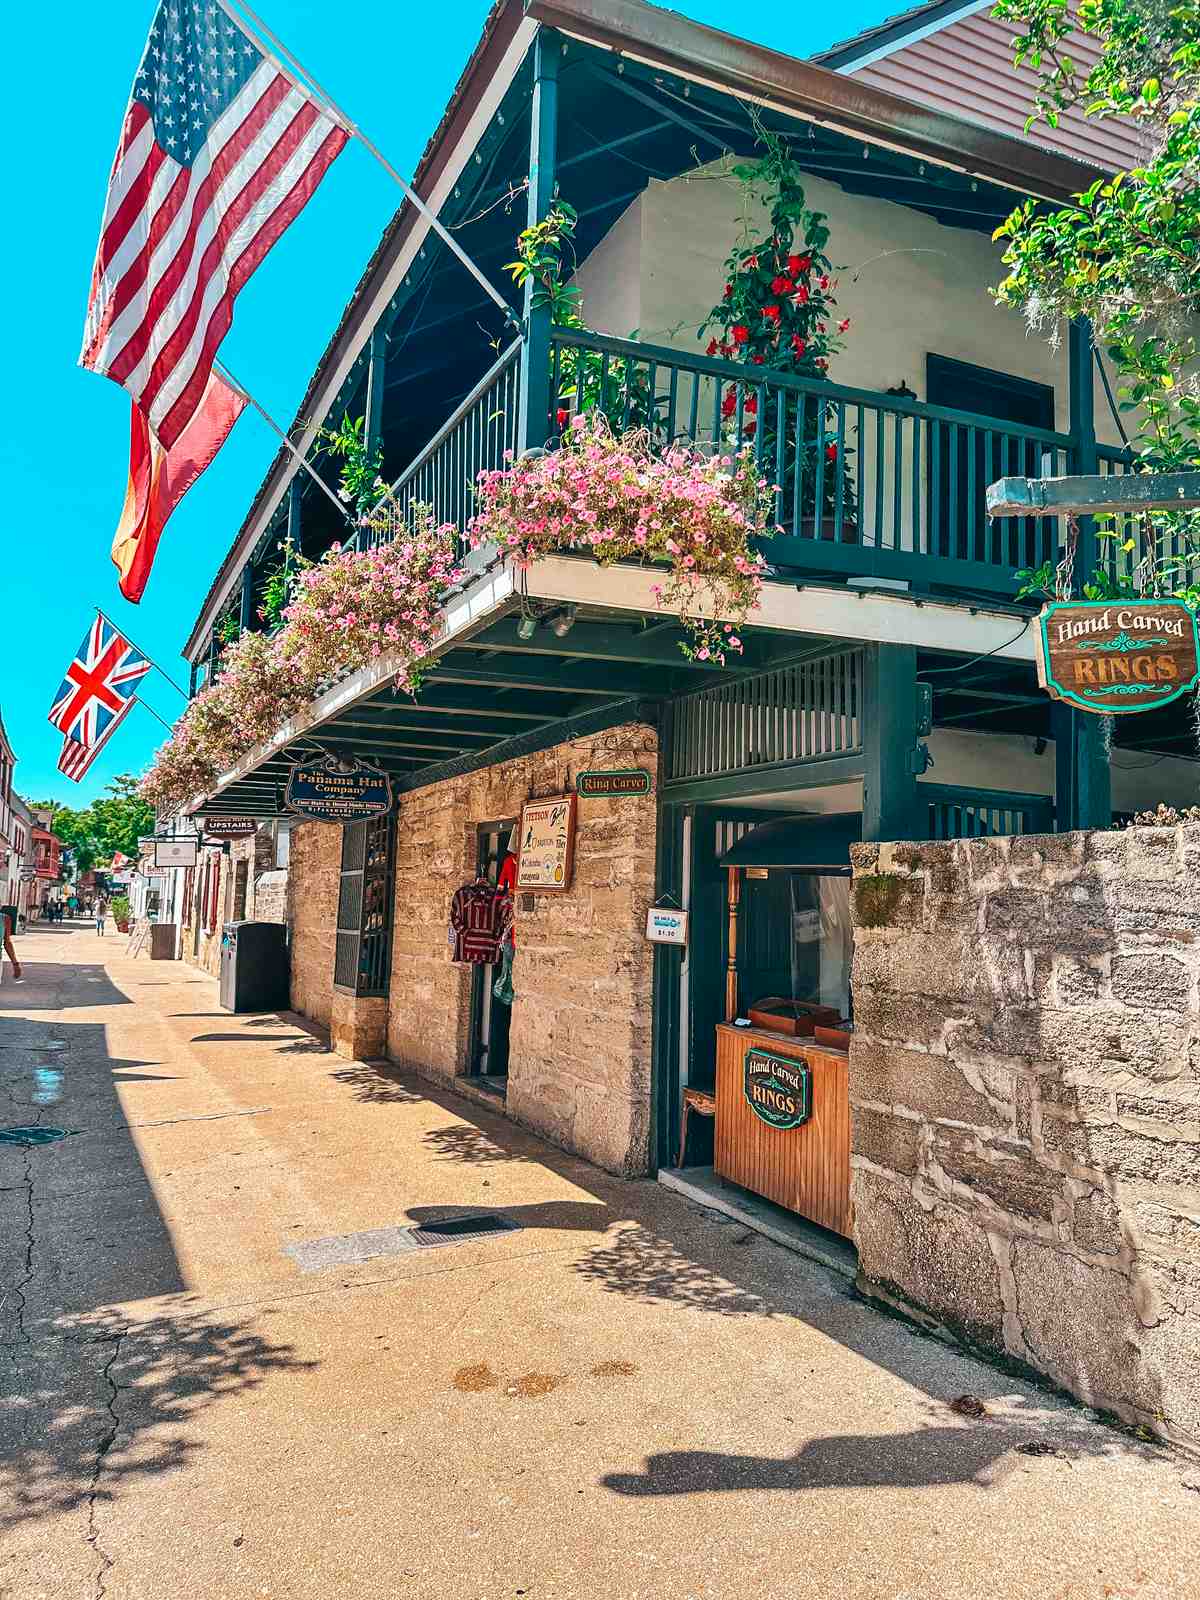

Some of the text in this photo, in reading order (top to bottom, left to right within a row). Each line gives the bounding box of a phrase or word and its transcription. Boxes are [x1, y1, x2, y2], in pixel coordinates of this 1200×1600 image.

[1057, 608, 1185, 644] Hand Carved
[1073, 655, 1178, 684] RINGS
[298, 773, 385, 788] Panama Hat
[315, 784, 367, 796] Company
[584, 778, 646, 792] Ring Carver
[525, 809, 549, 823] STETSON
[750, 1058, 799, 1089] Hand Carved
[753, 1085, 795, 1114] RINGS
